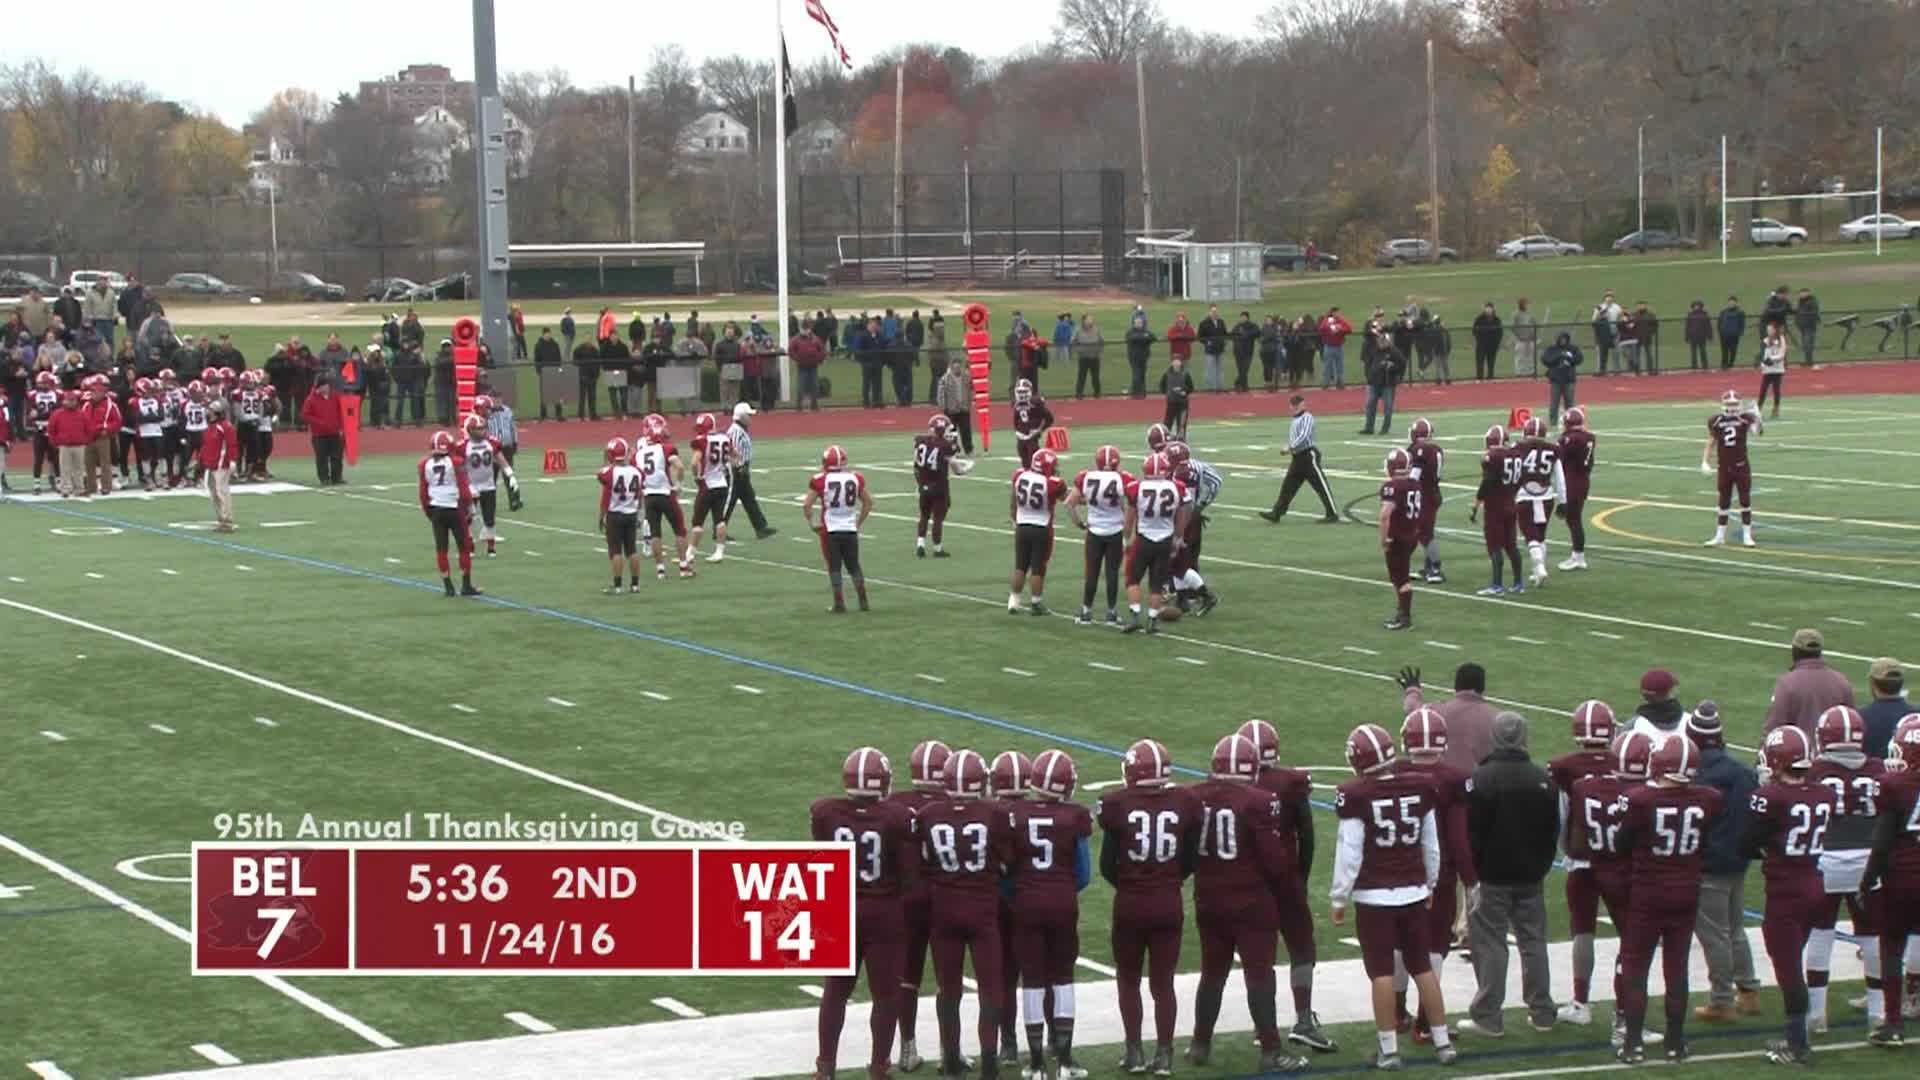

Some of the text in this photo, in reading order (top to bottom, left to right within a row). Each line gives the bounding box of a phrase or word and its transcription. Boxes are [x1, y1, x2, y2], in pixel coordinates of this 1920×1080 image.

[1724, 426, 1737, 447] 2
[548, 451, 567, 471] 20
[643, 451, 655, 475] 5
[917, 443, 939, 471] 34
[1503, 457, 1521, 485] 58
[1523, 448, 1554, 474] 45
[432, 464, 446, 486] 7
[614, 475, 640, 501] 44
[828, 480, 857, 508] 78
[1017, 478, 1045, 509] 55
[1087, 478, 1119, 507] 74
[1141, 488, 1174, 518] 72
[1406, 490, 1421, 519] 59
[1371, 794, 1421, 848] 55
[1652, 805, 1704, 857] 56
[1785, 803, 1830, 857] 22
[930, 823, 988, 872] 83
[1027, 816, 1054, 870] 5
[1127, 810, 1179, 863] 36
